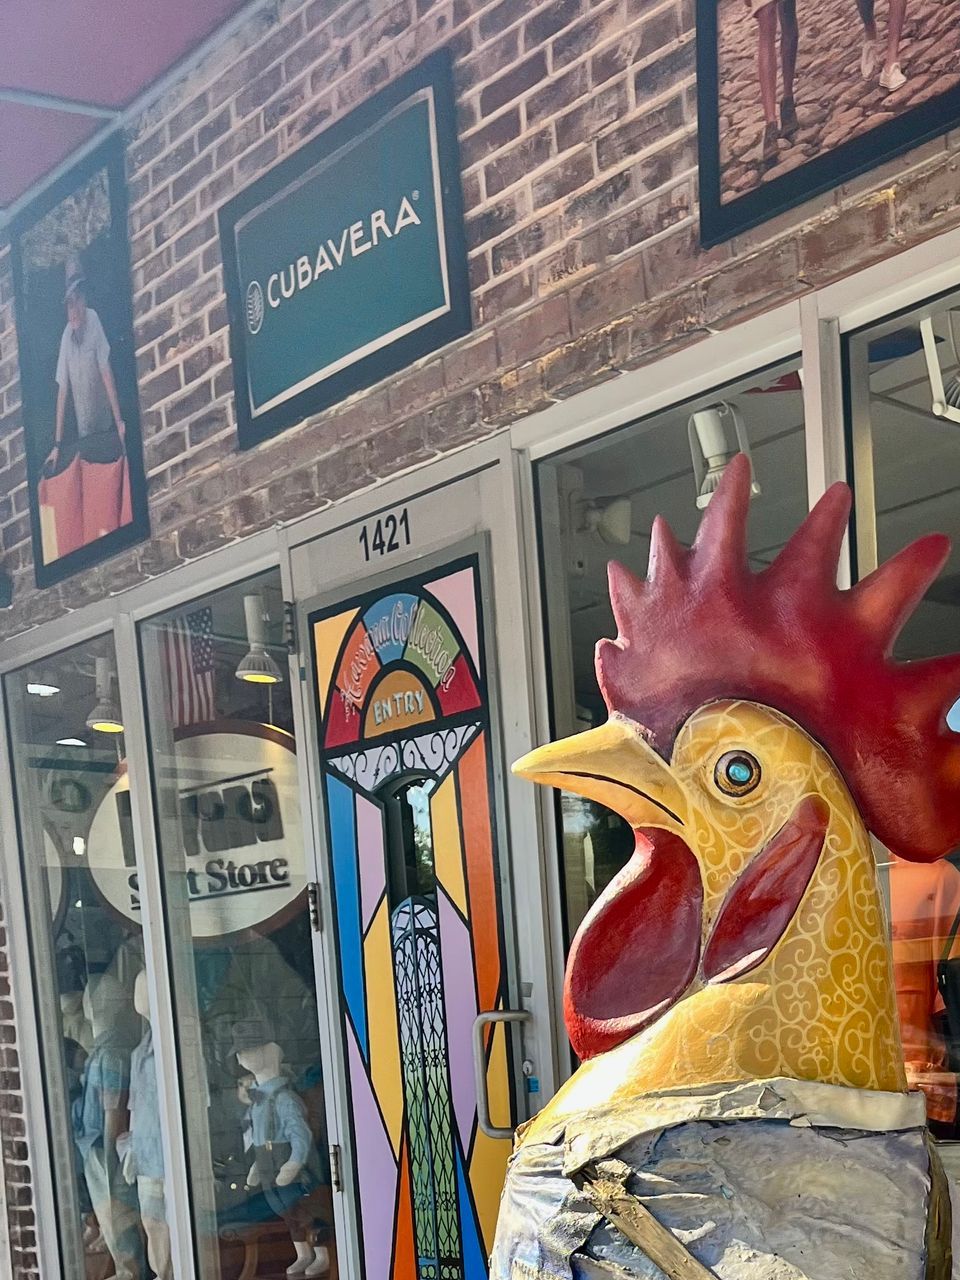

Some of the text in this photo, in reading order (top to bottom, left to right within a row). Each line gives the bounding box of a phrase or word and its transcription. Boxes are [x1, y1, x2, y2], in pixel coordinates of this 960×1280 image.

[358, 507, 411, 562] 1421
[373, 690, 424, 726] ENTRY
[205, 858, 289, 894] Store
